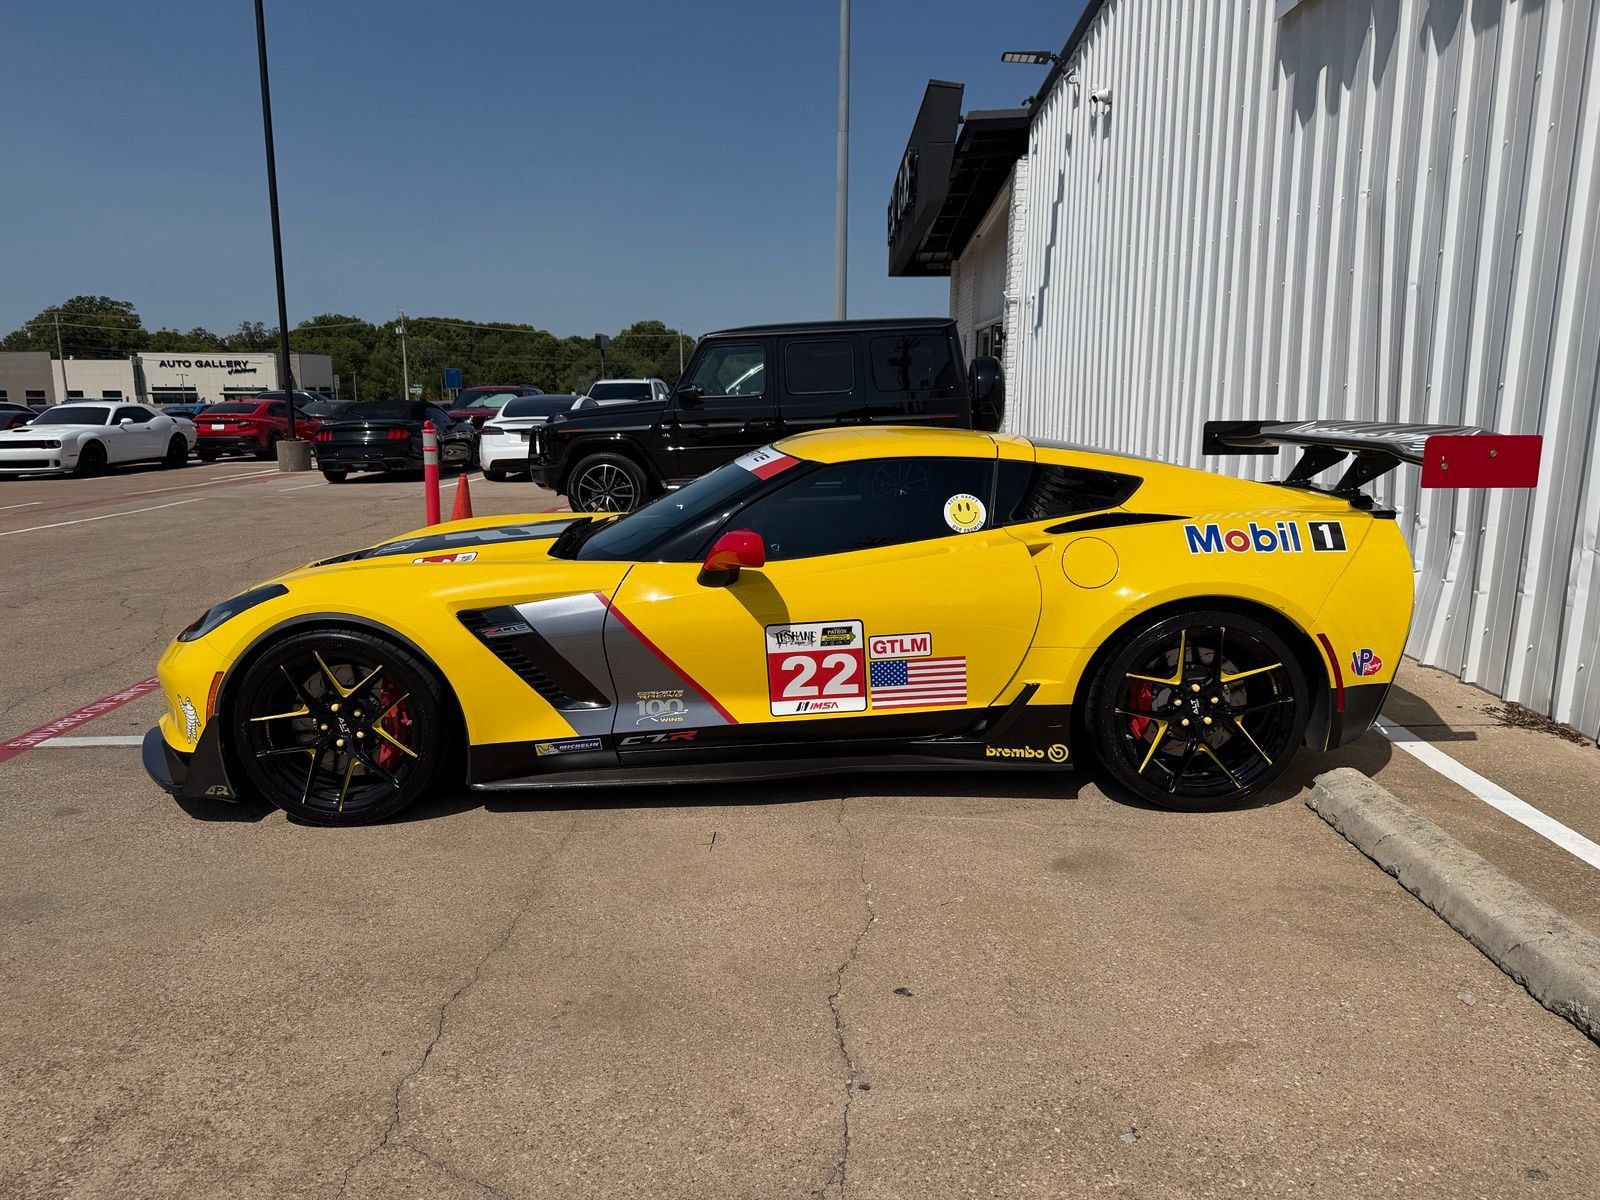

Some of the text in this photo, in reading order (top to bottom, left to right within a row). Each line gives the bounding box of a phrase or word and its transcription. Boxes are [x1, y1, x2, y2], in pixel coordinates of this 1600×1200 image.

[159, 360, 249, 368] AUTO GALLERY
[1184, 521, 1302, 553] Mobil
[872, 637, 927, 654] GTLM
[1352, 648, 1373, 676] VP
[781, 653, 859, 698] 22
[636, 699, 684, 715] 100
[810, 702, 838, 710] IMSA
[620, 731, 698, 745] C7.R
[559, 742, 599, 750] MICHELIN
[986, 745, 1045, 759] brembo
